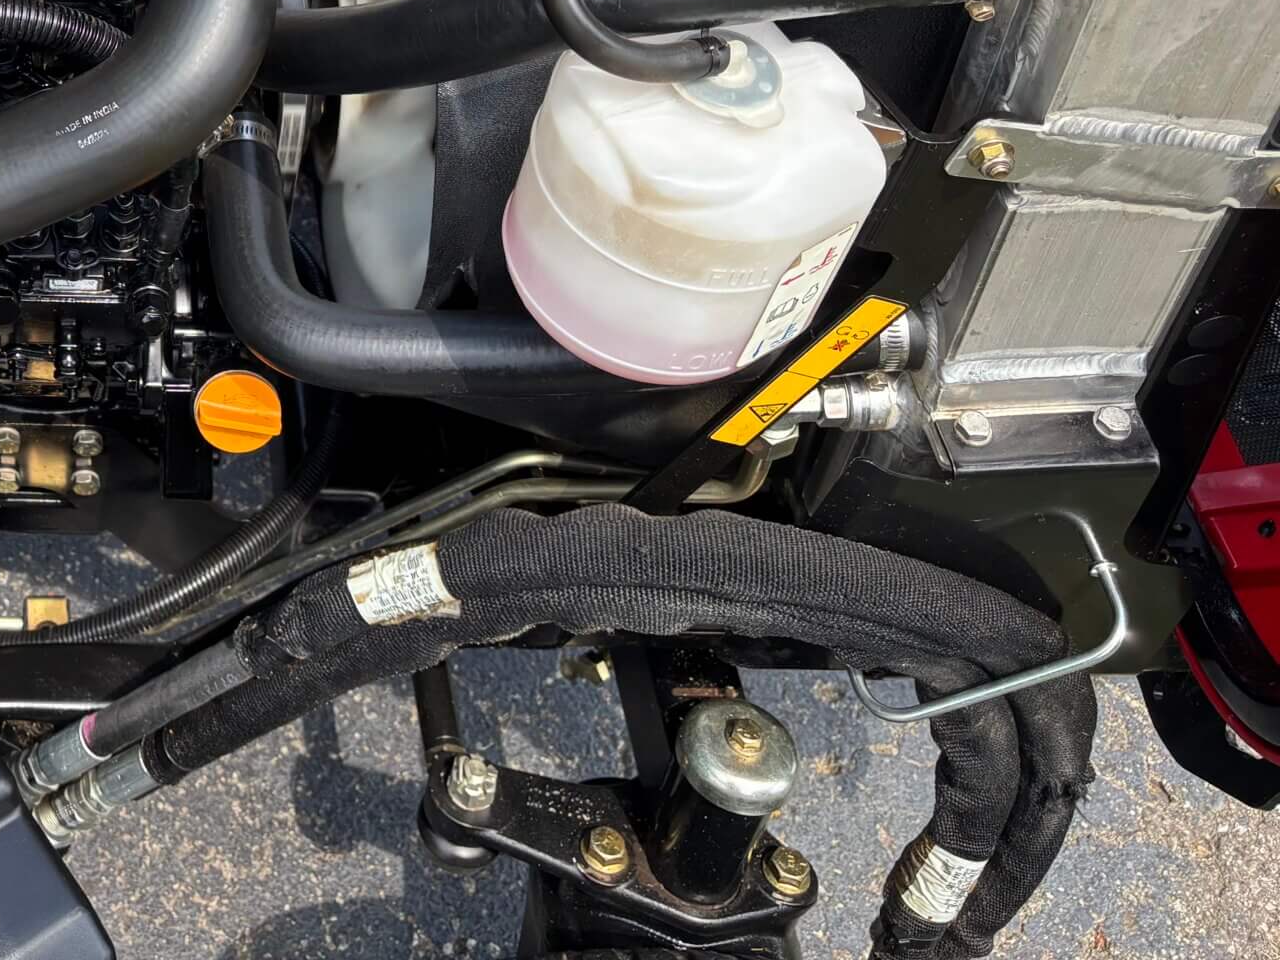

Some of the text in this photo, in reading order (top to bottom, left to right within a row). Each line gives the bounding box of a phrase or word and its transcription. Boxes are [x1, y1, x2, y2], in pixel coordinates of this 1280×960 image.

[81, 114, 93, 126] IN
[93, 101, 120, 120] INDIA
[706, 266, 768, 287] FULL
[668, 351, 733, 371] LOW
